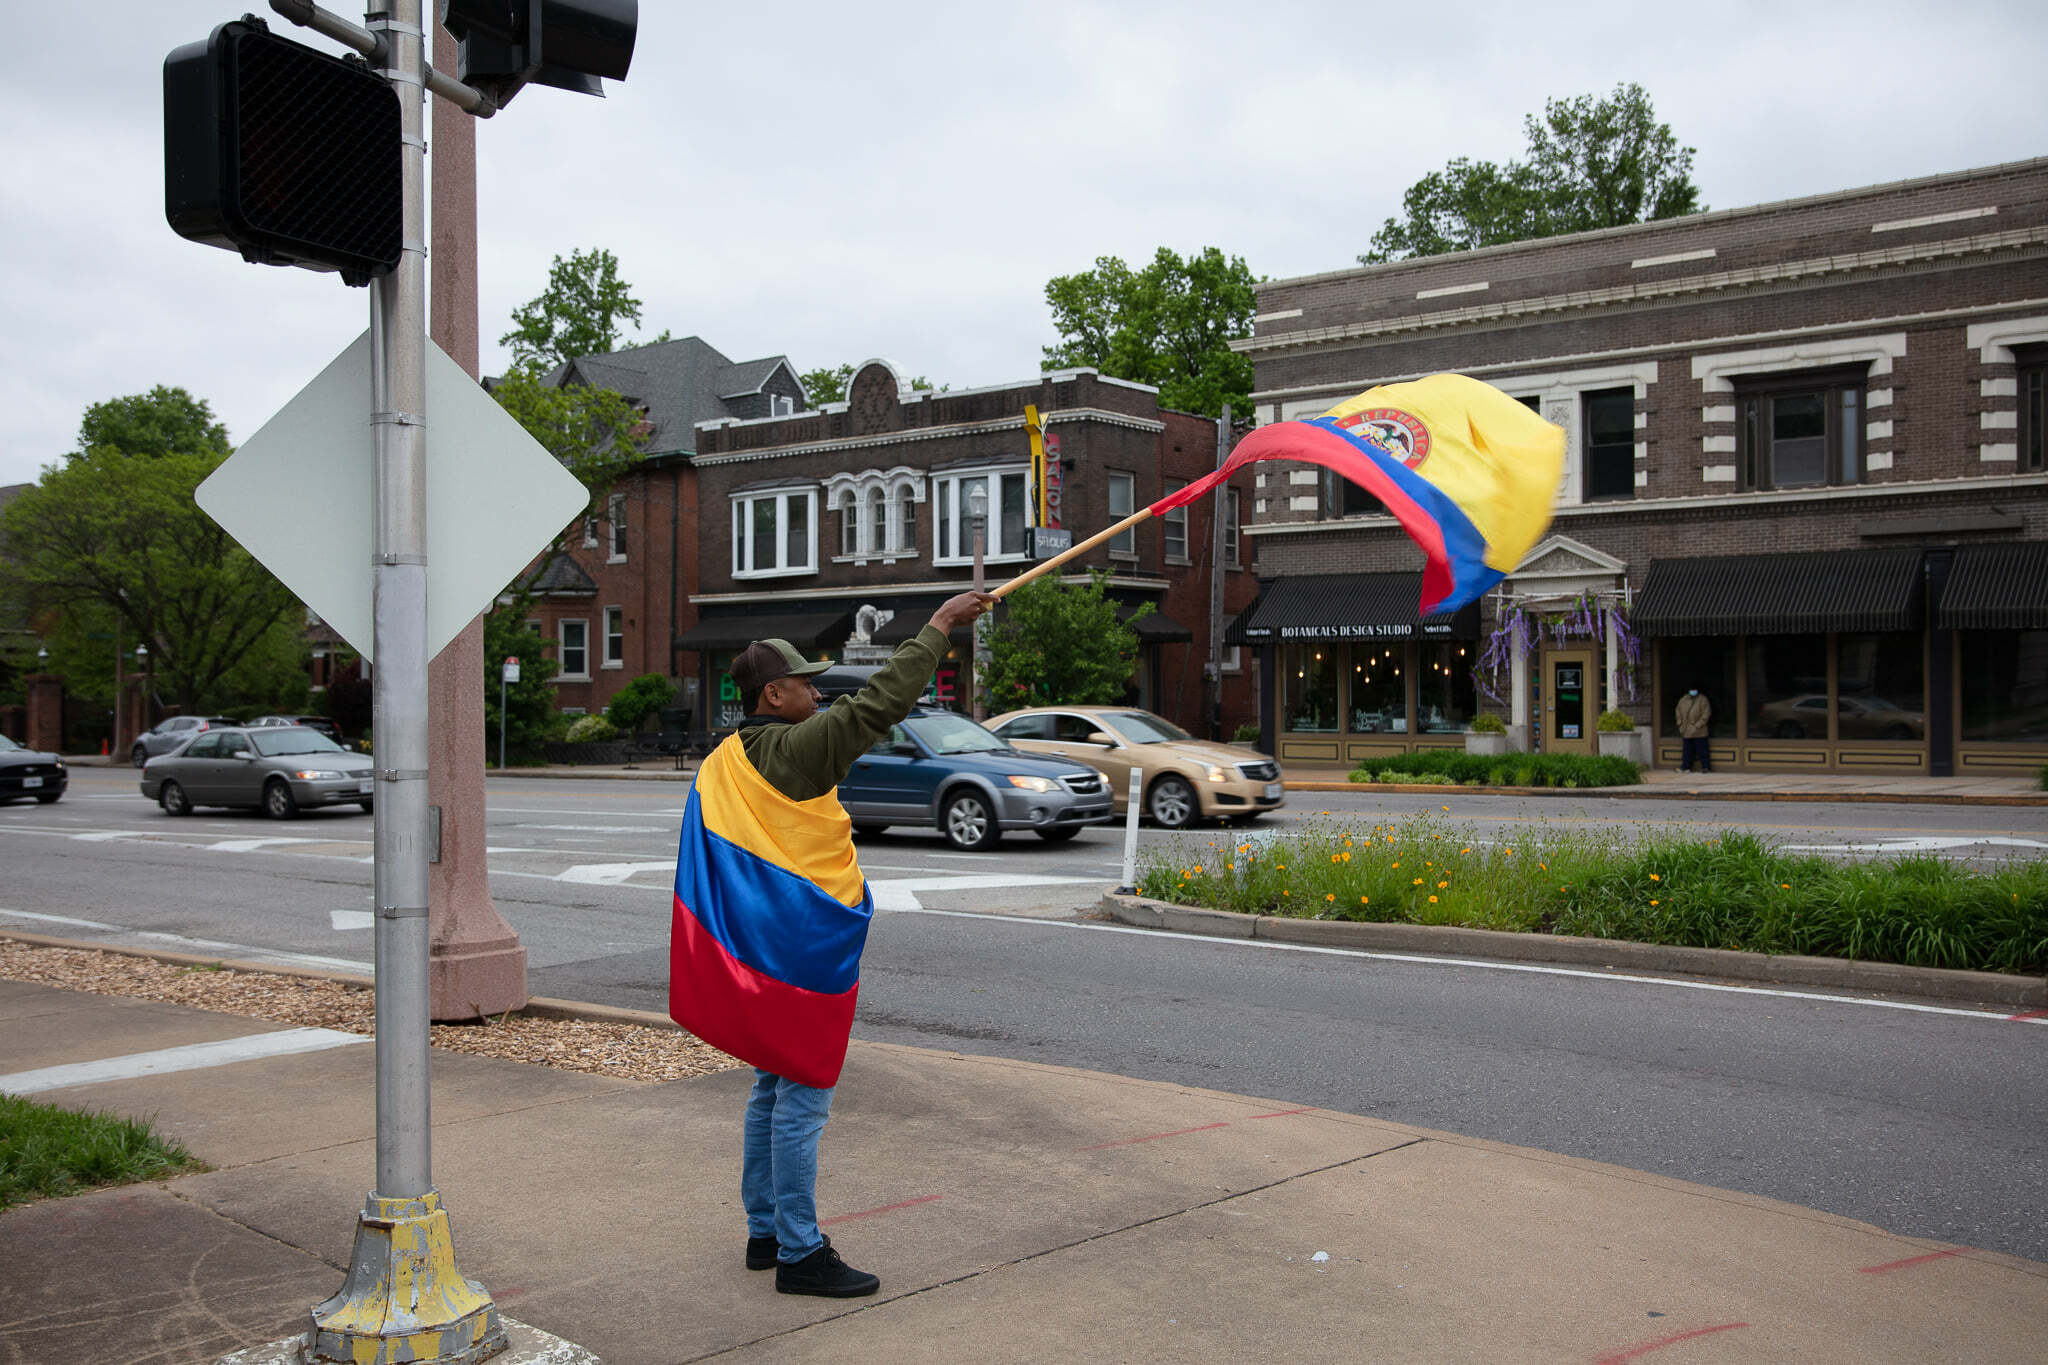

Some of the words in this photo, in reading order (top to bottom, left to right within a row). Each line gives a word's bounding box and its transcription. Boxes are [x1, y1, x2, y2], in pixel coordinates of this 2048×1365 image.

[1046, 444, 1061, 523] SALON
[1281, 625, 1338, 637] BOTANICALS
[1339, 625, 1374, 636] DESIGN
[1375, 624, 1412, 635] STUDIO
